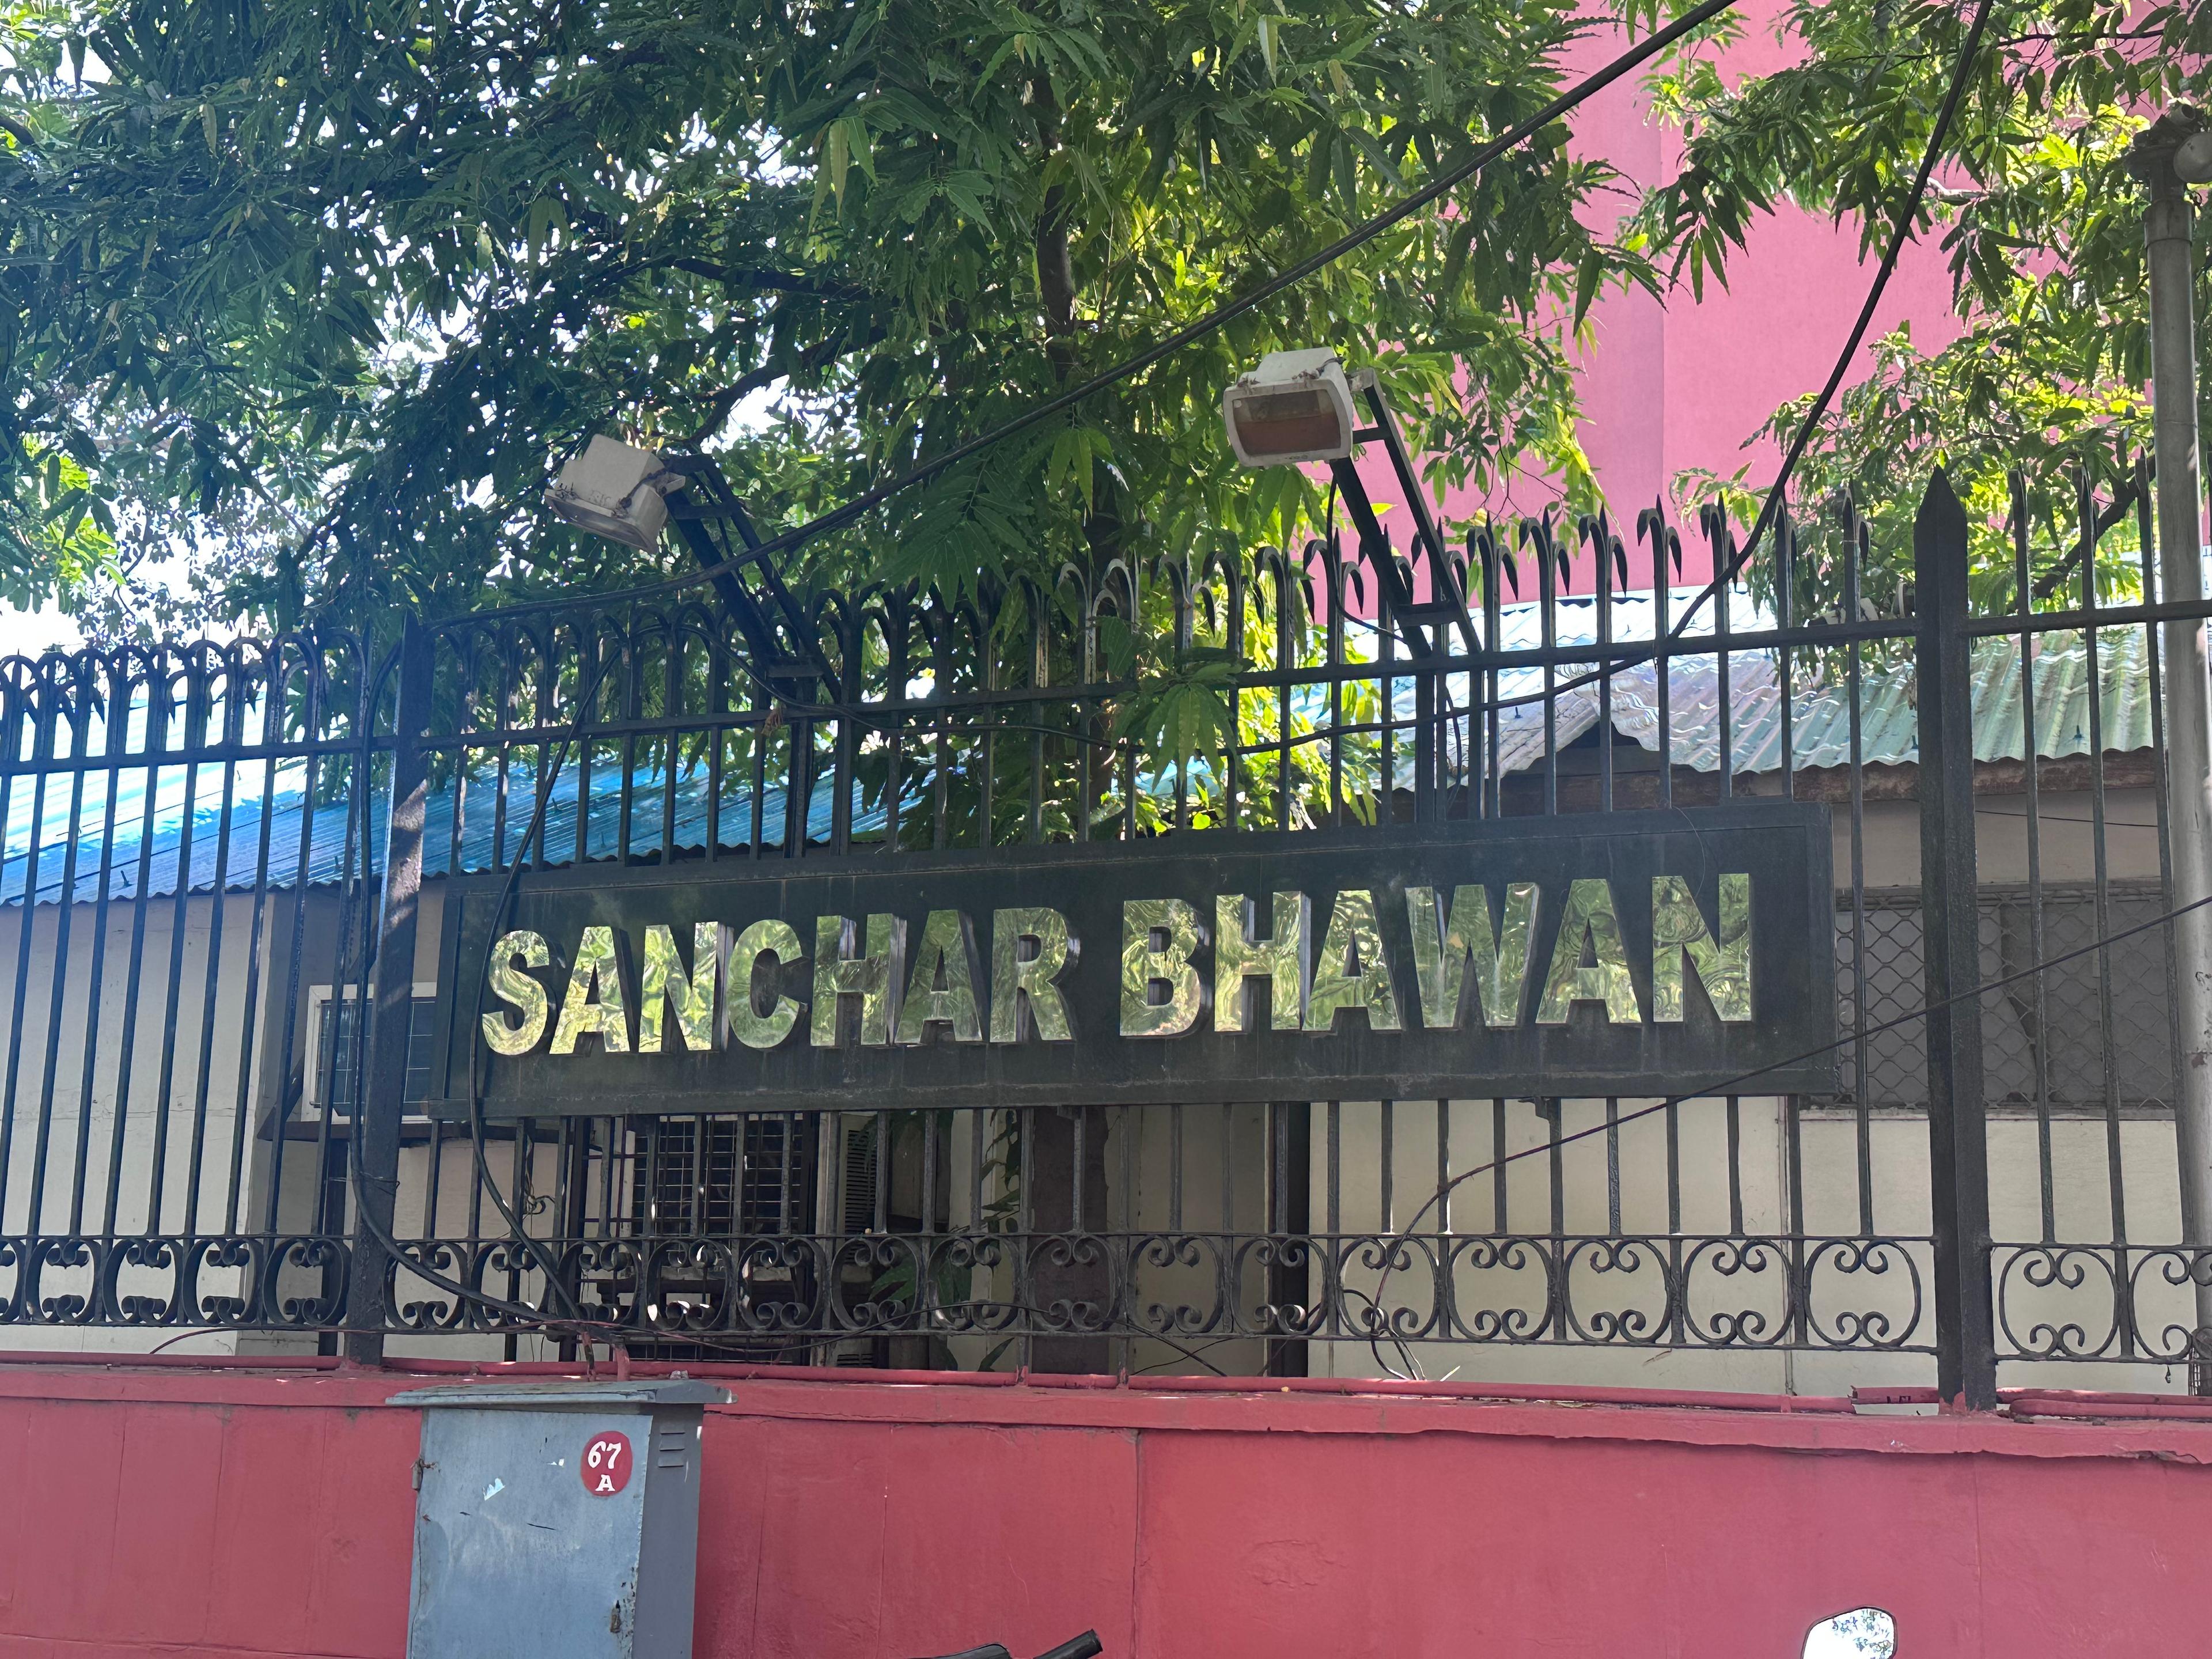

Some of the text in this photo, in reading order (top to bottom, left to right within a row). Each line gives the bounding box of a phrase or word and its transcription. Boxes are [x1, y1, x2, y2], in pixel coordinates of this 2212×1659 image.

[482, 872, 1752, 1056] SANCHAR BHAWAN
[588, 1441, 622, 1469] 67
[595, 1474, 615, 1491] A
